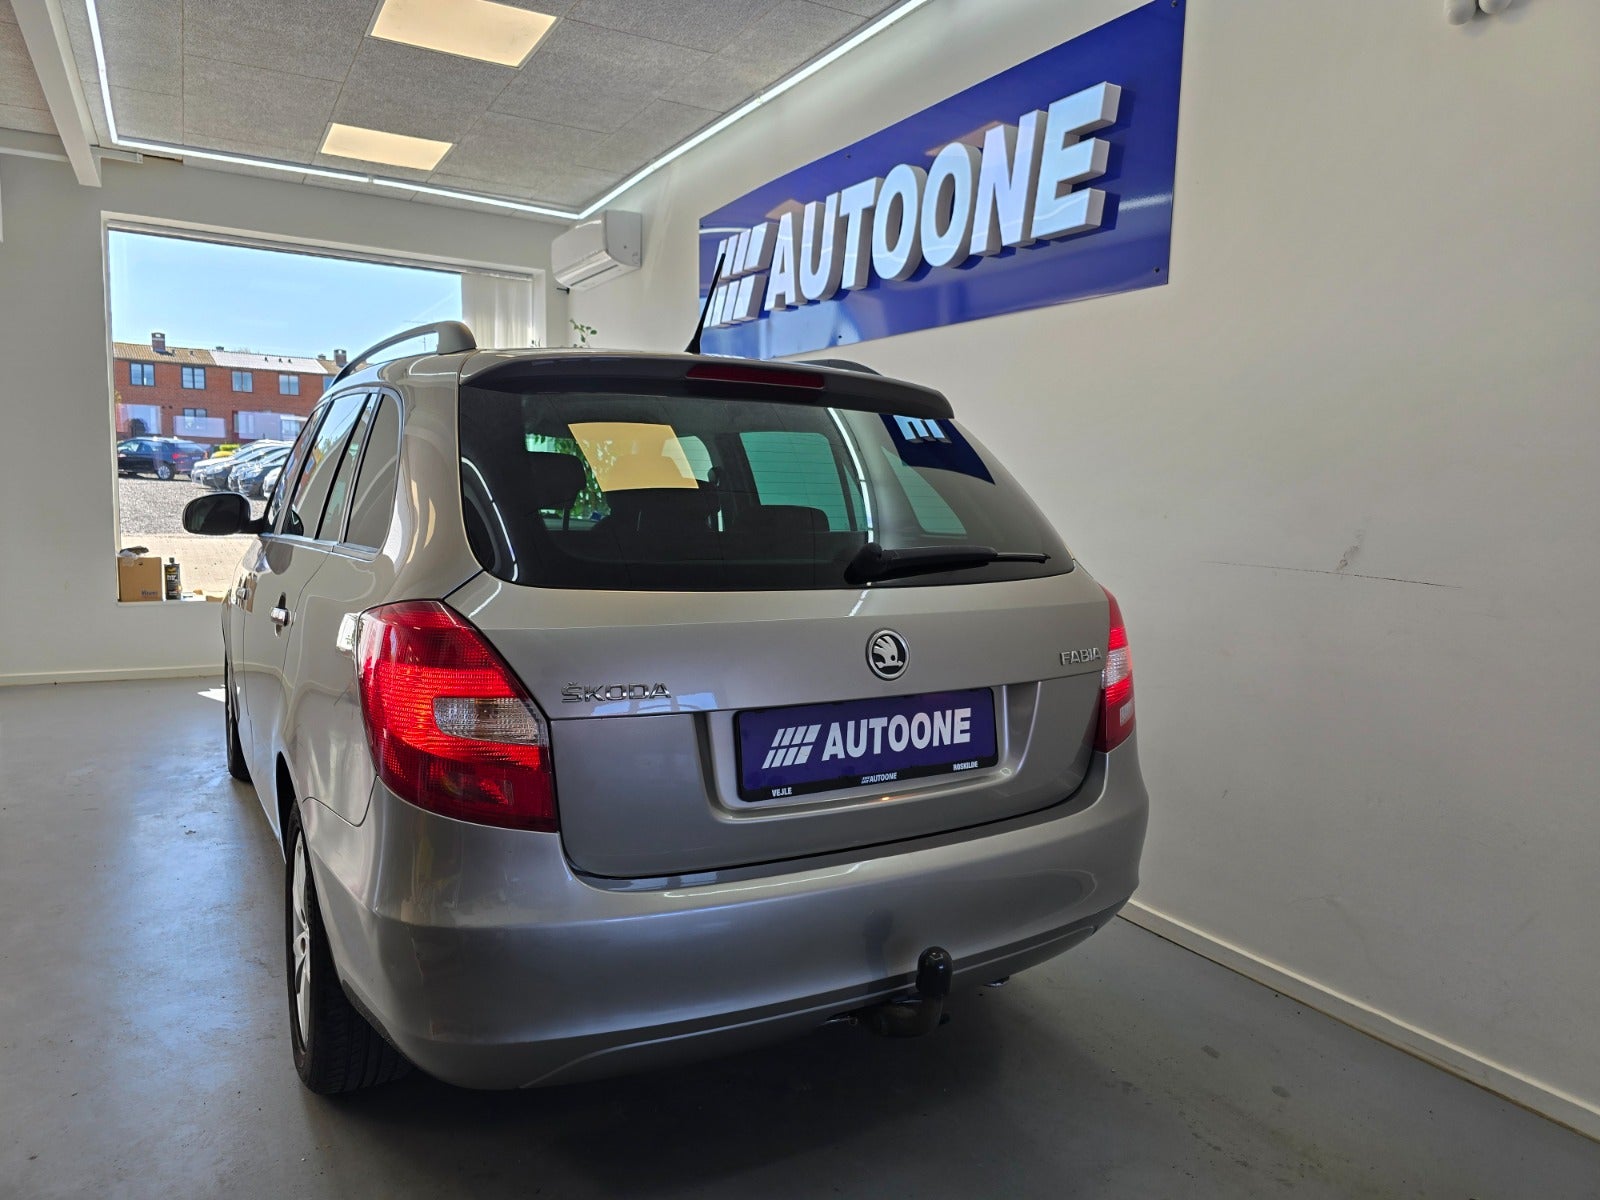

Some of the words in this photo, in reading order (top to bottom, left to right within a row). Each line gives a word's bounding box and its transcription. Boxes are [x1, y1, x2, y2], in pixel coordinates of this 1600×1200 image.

[764, 81, 1122, 312] AUTOONE
[1060, 647, 1101, 665] FABIA
[561, 682, 672, 703] ŠKODA
[821, 708, 972, 761] AUTOONE
[869, 772, 897, 783] AUTOONE
[771, 787, 792, 797] VEJLE
